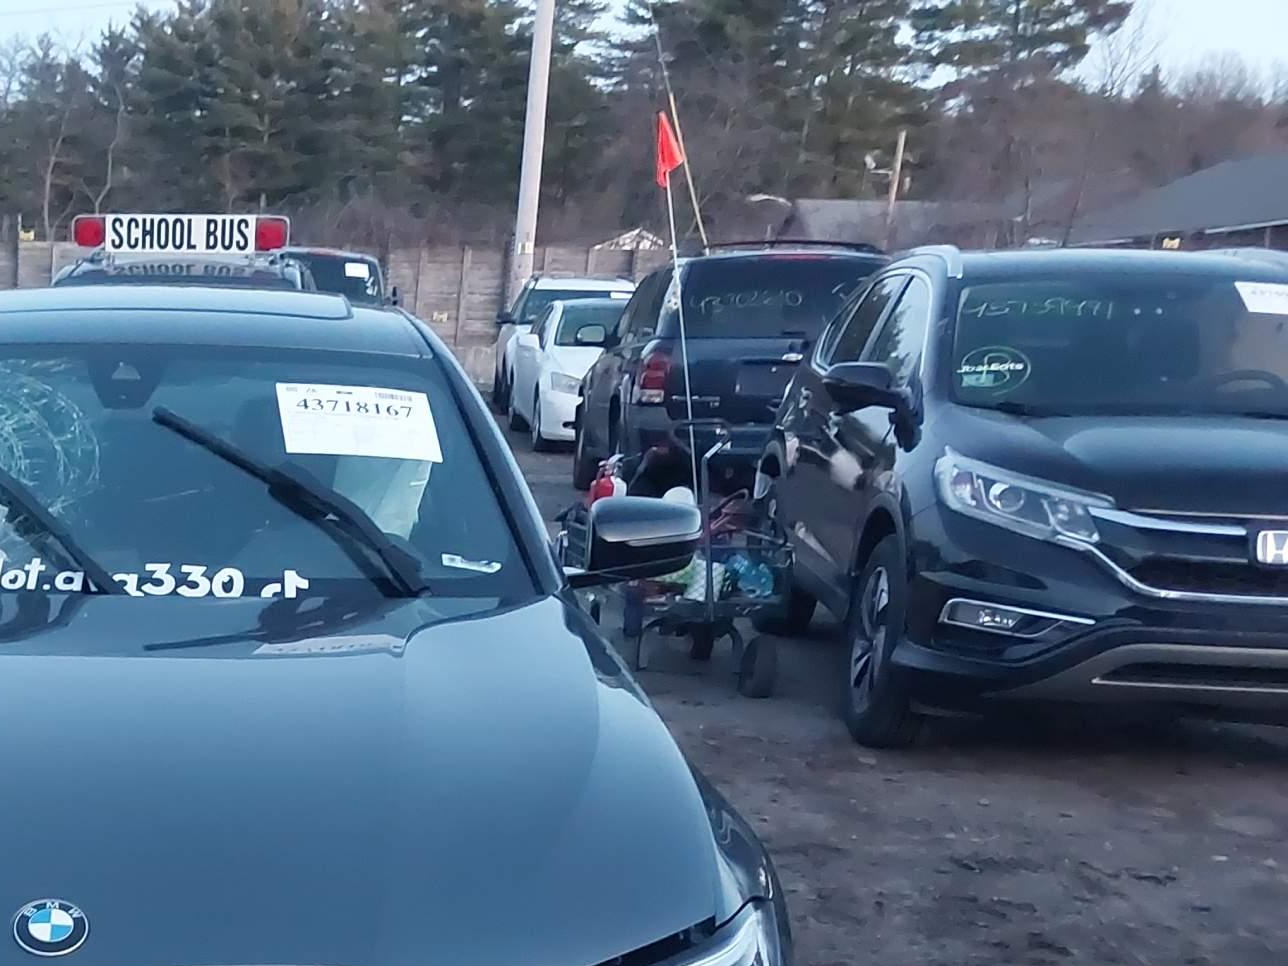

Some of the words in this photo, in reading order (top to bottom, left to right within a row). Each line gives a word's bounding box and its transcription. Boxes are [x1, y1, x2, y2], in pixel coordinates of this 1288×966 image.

[111, 217, 196, 250] SCHOOL
[205, 218, 250, 251] BUS
[296, 398, 413, 418] 43718167
[24, 902, 83, 918] BMW
